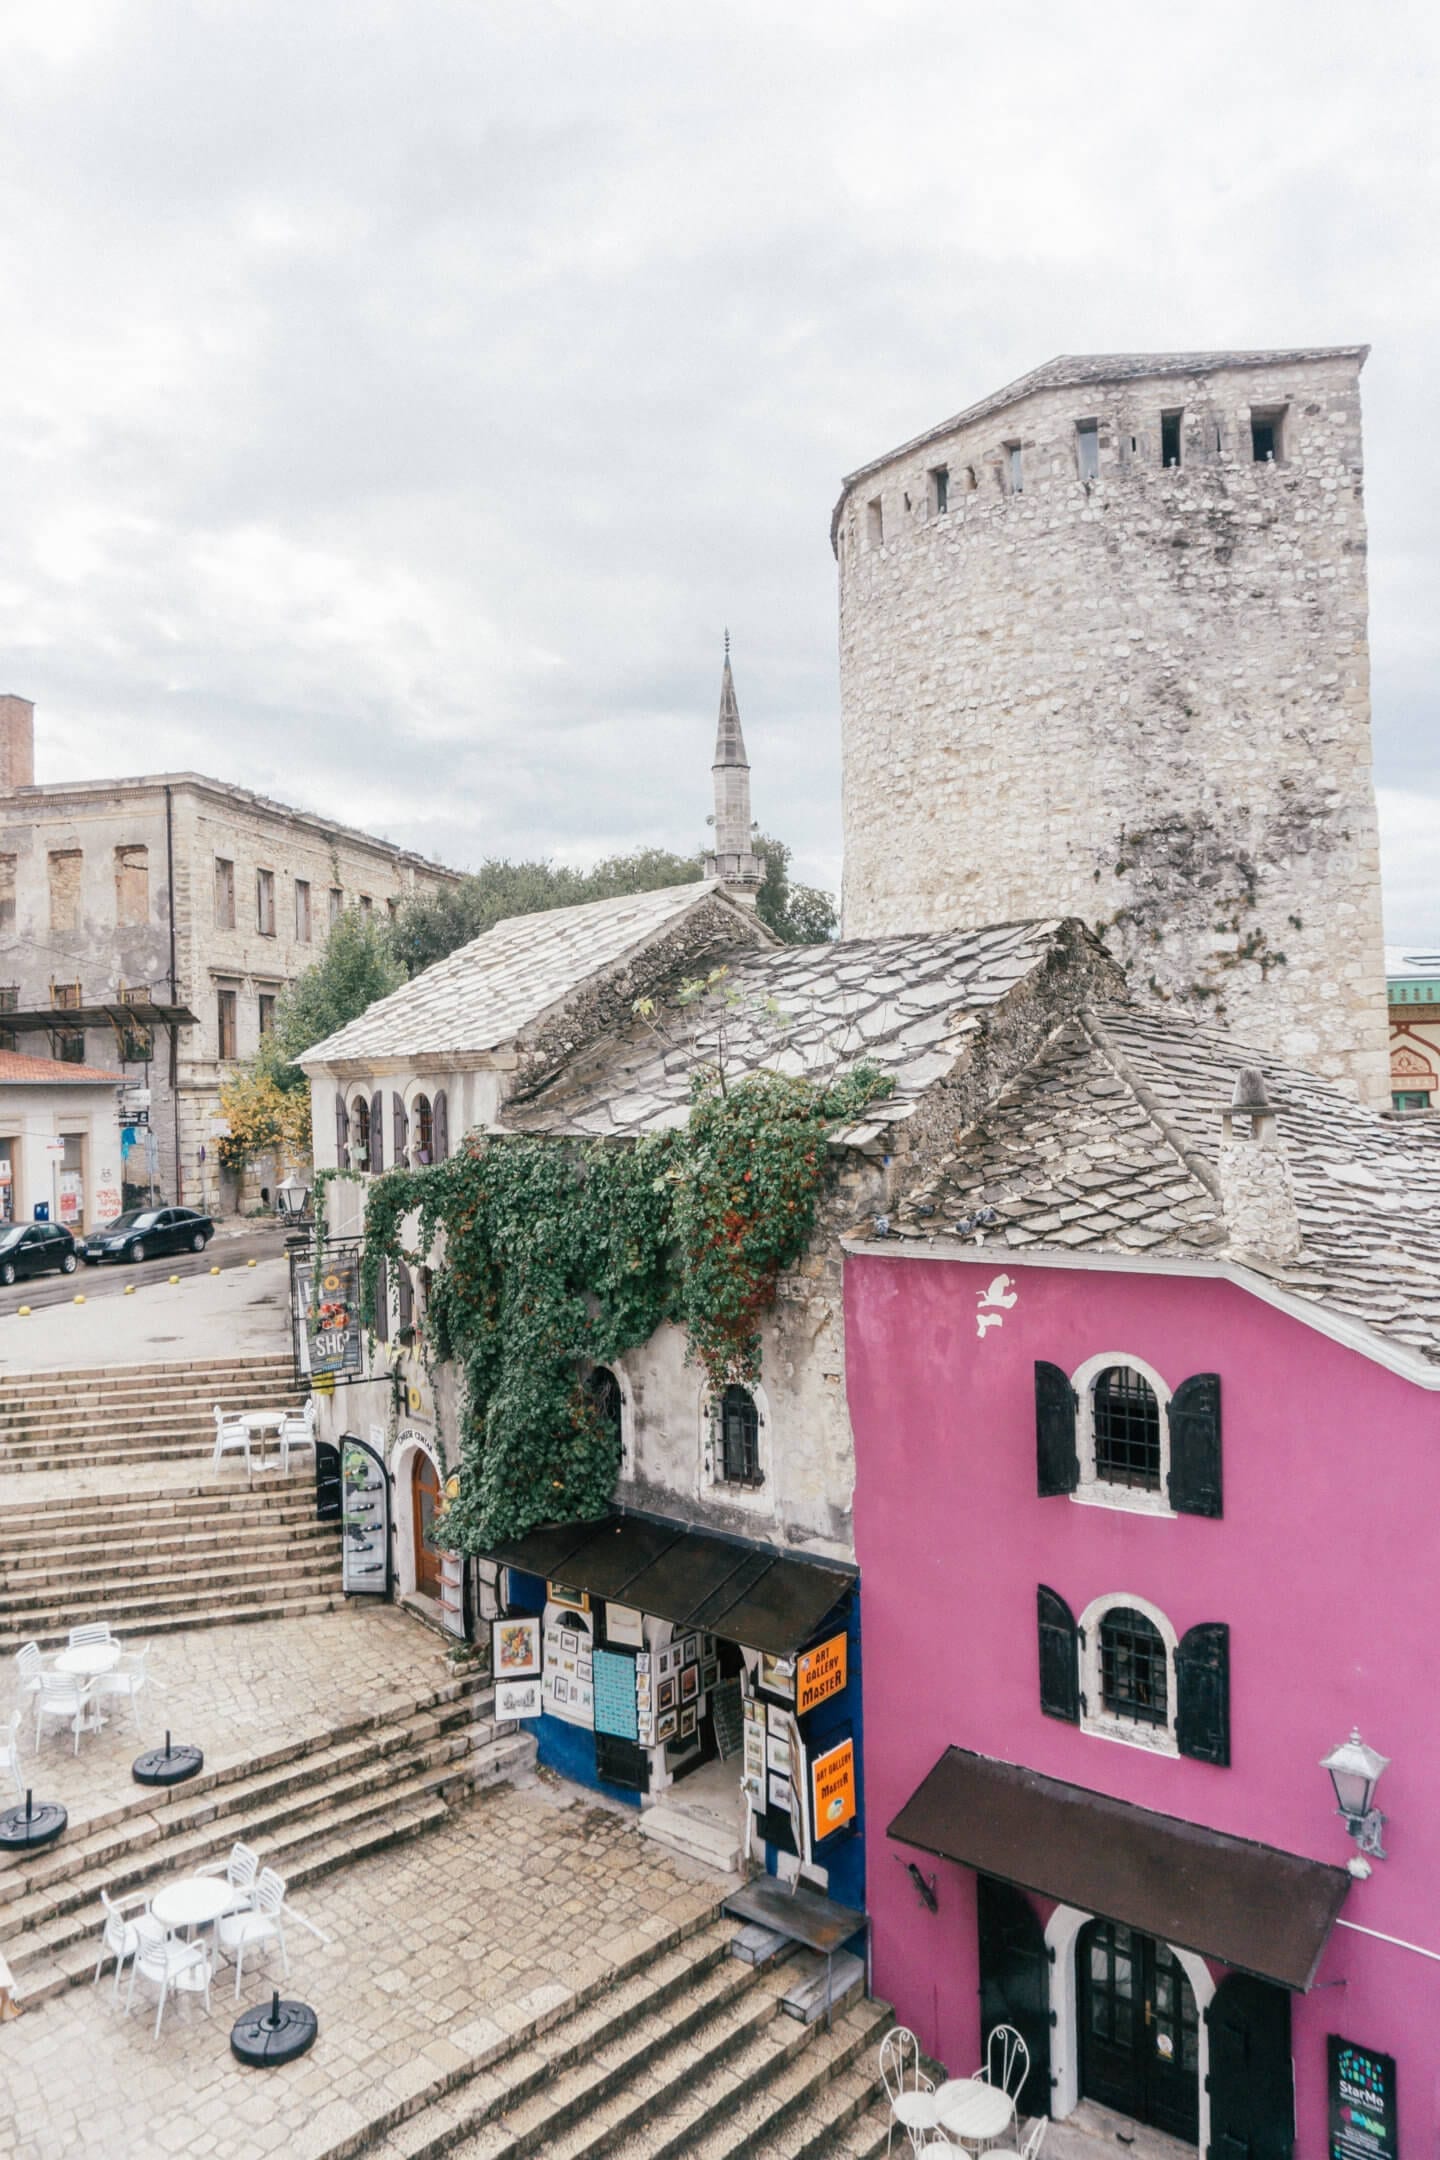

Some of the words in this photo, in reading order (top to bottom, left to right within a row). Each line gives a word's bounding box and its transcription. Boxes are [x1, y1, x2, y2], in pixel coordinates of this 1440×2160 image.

[806, 1655, 840, 1684] GALLERY
[815, 1647, 830, 1665] ART
[802, 1669, 842, 1707] MASTER
[816, 1767, 828, 1783] ART
[828, 1751, 852, 1775] GALLERY
[821, 1772, 849, 1800] MASTER
[1340, 2079, 1384, 2108] StarMo
